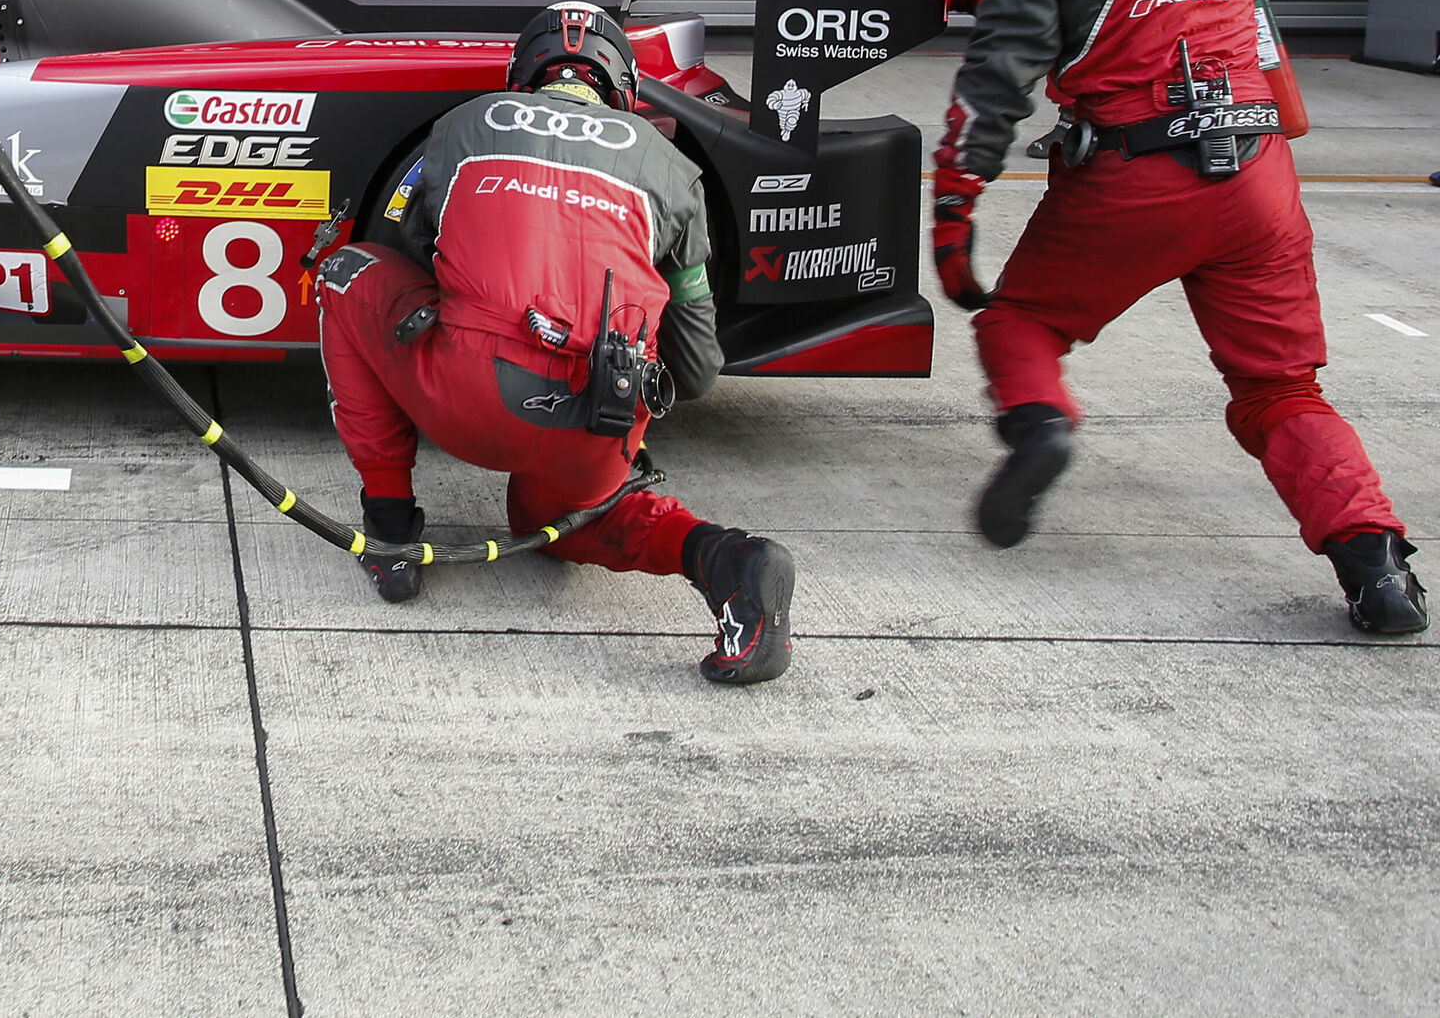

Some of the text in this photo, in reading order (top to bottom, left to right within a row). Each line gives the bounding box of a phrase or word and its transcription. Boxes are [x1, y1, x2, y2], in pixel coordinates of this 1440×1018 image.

[776, 7, 891, 43] ORIS
[775, 43, 888, 59] Swiss Watches
[201, 95, 303, 127] Castrol
[160, 134, 320, 167] EDGE
[171, 180, 304, 209] DHL
[504, 178, 629, 221] Audi Sport
[749, 203, 842, 233] MAHLE
[197, 221, 287, 337] 8
